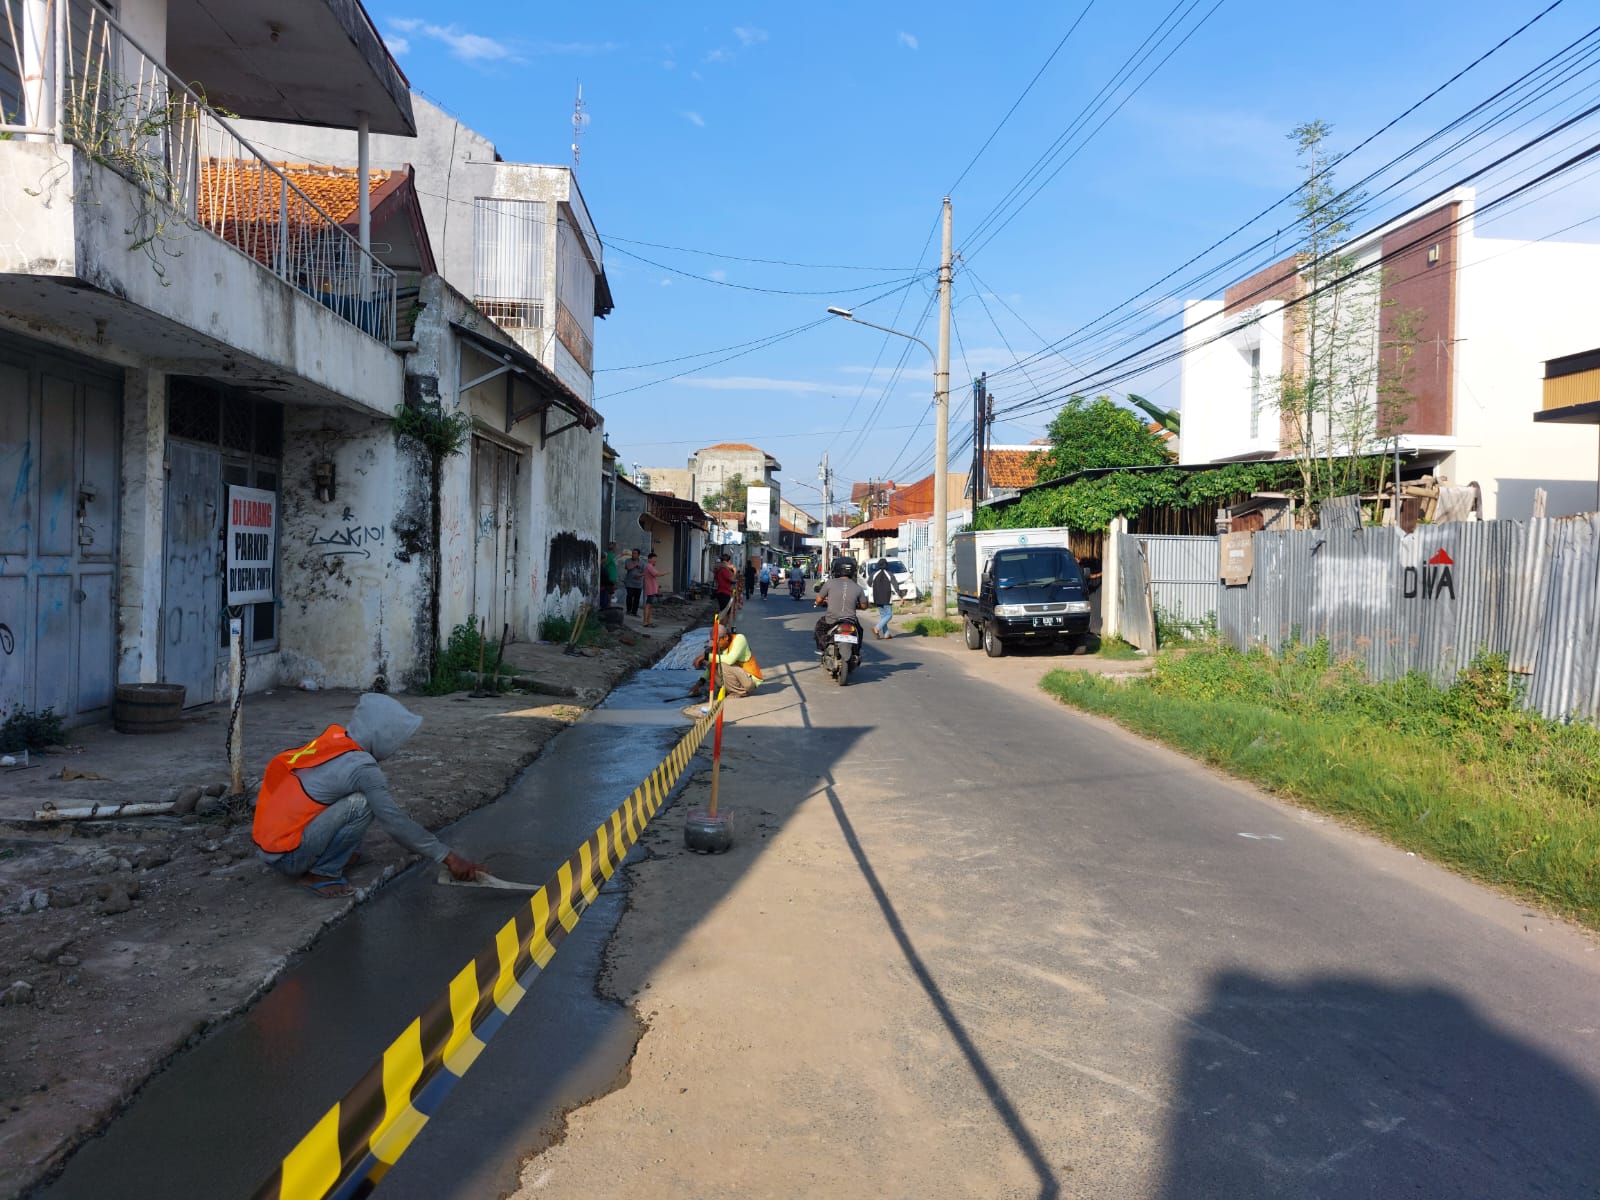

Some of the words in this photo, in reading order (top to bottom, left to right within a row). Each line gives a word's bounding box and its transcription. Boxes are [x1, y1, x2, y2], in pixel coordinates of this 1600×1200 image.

[232, 499, 241, 525] DI
[243, 500, 272, 528] LARANG
[235, 532, 269, 561] PARKIR
[230, 567, 236, 592] DI
[238, 567, 255, 591] DEPAN
